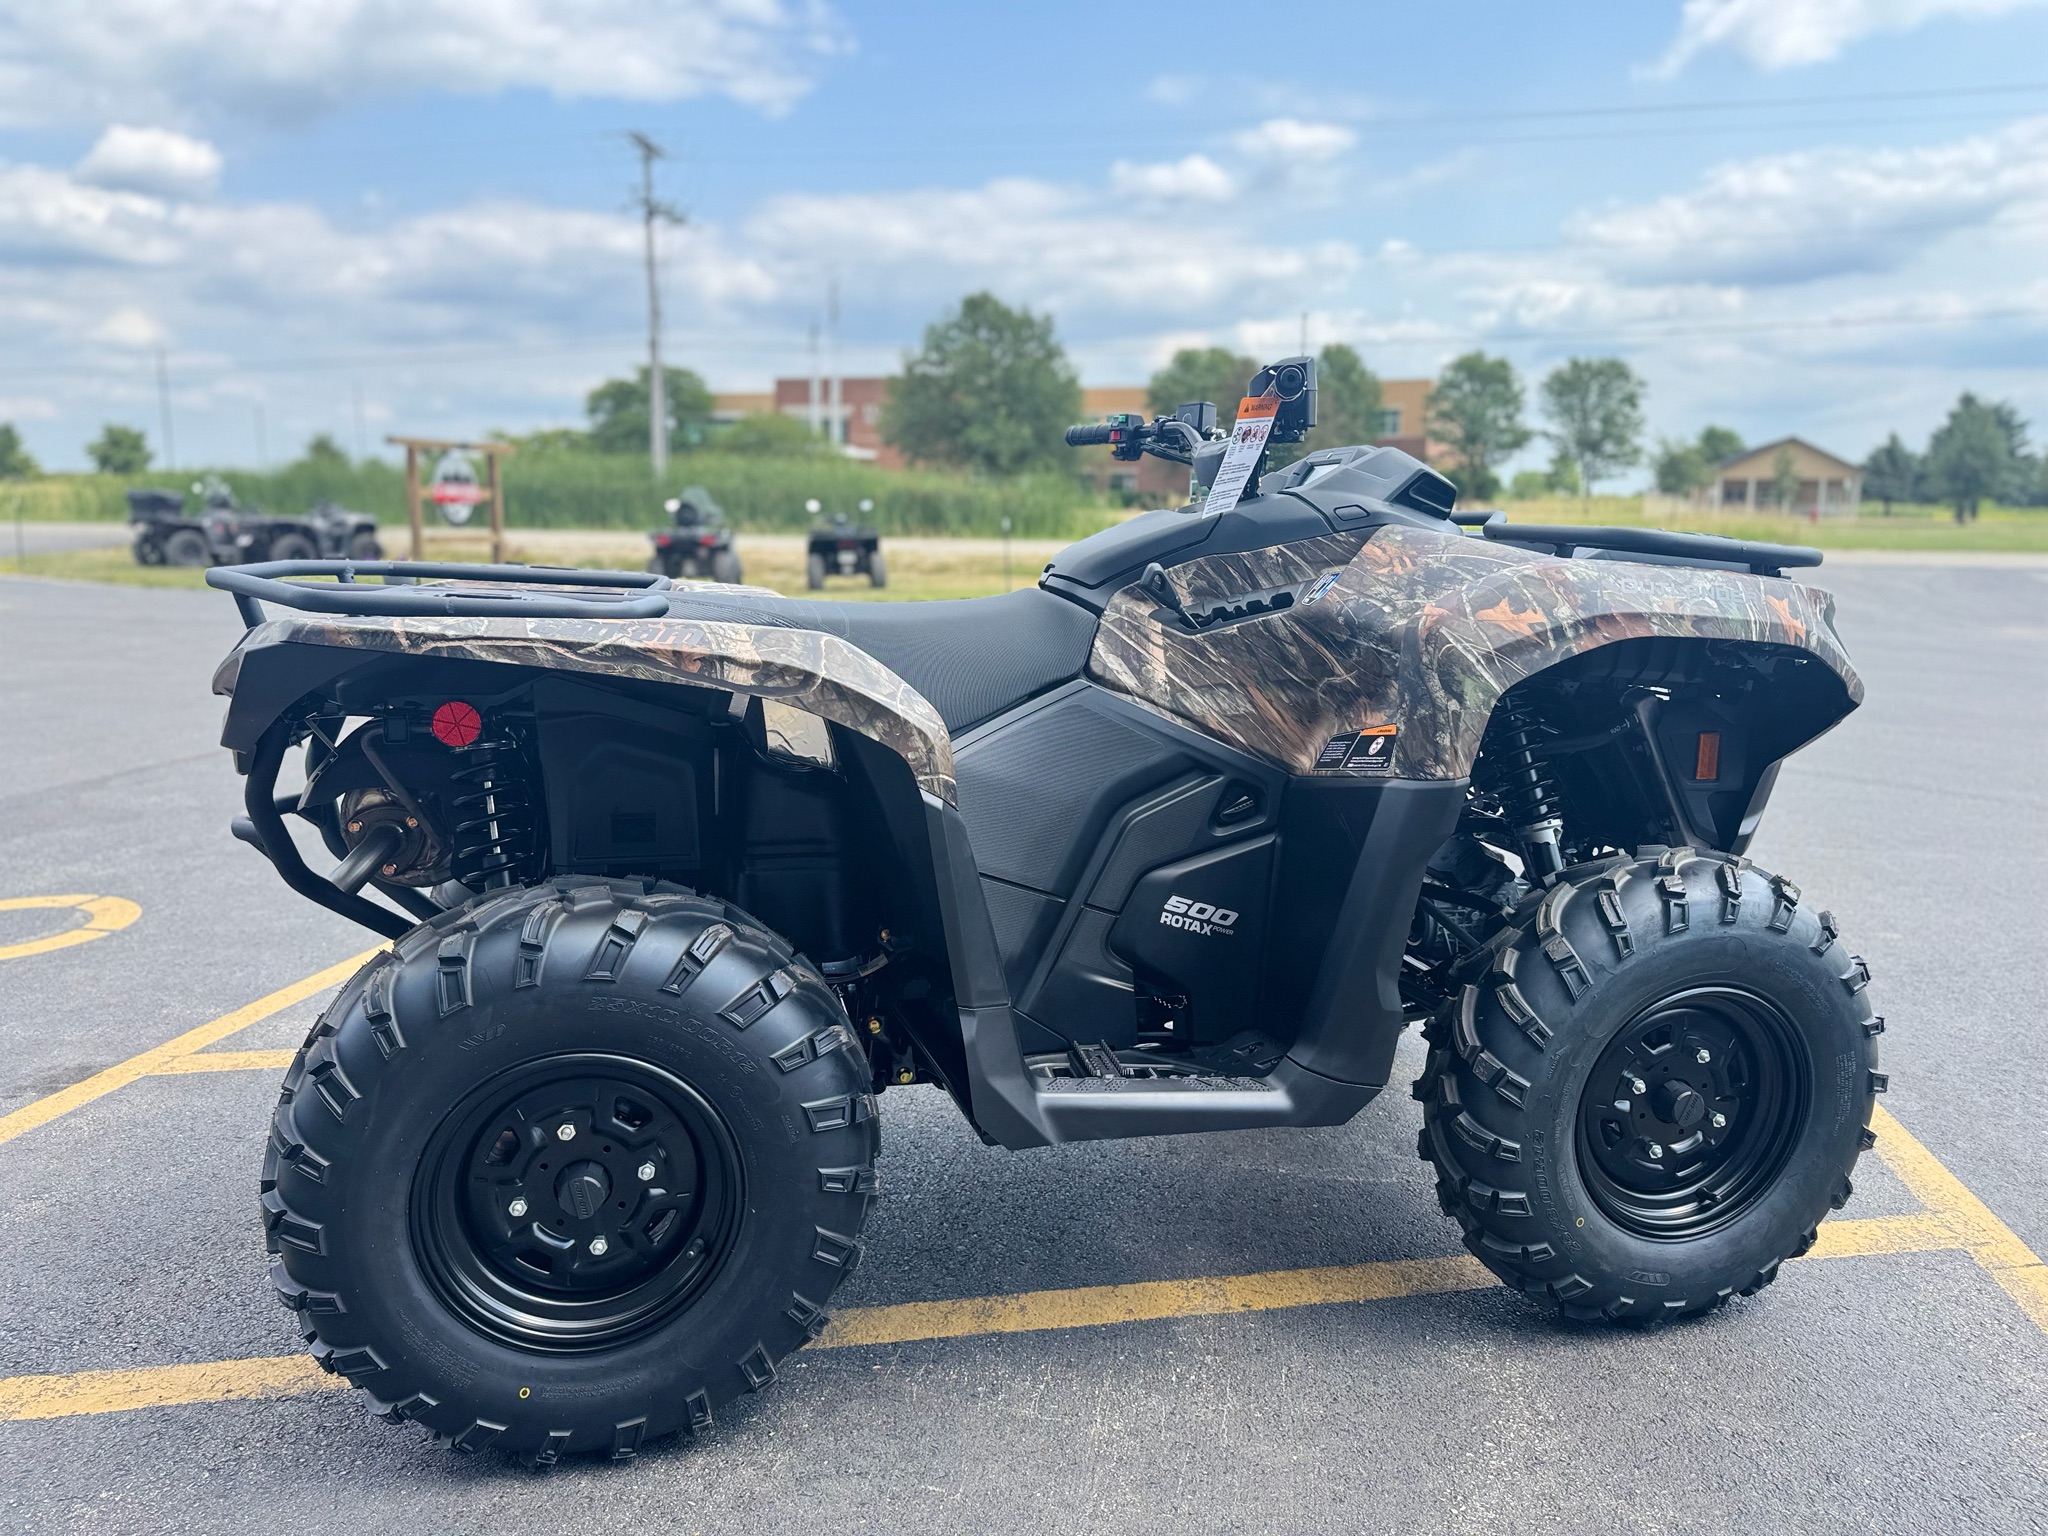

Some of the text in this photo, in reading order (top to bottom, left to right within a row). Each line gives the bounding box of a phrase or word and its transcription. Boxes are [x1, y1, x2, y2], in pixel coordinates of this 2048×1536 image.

[1621, 578, 1758, 603] OUTLANDER
[1164, 895, 1239, 926] 500
[1160, 912, 1234, 936] ROTAX POWER
